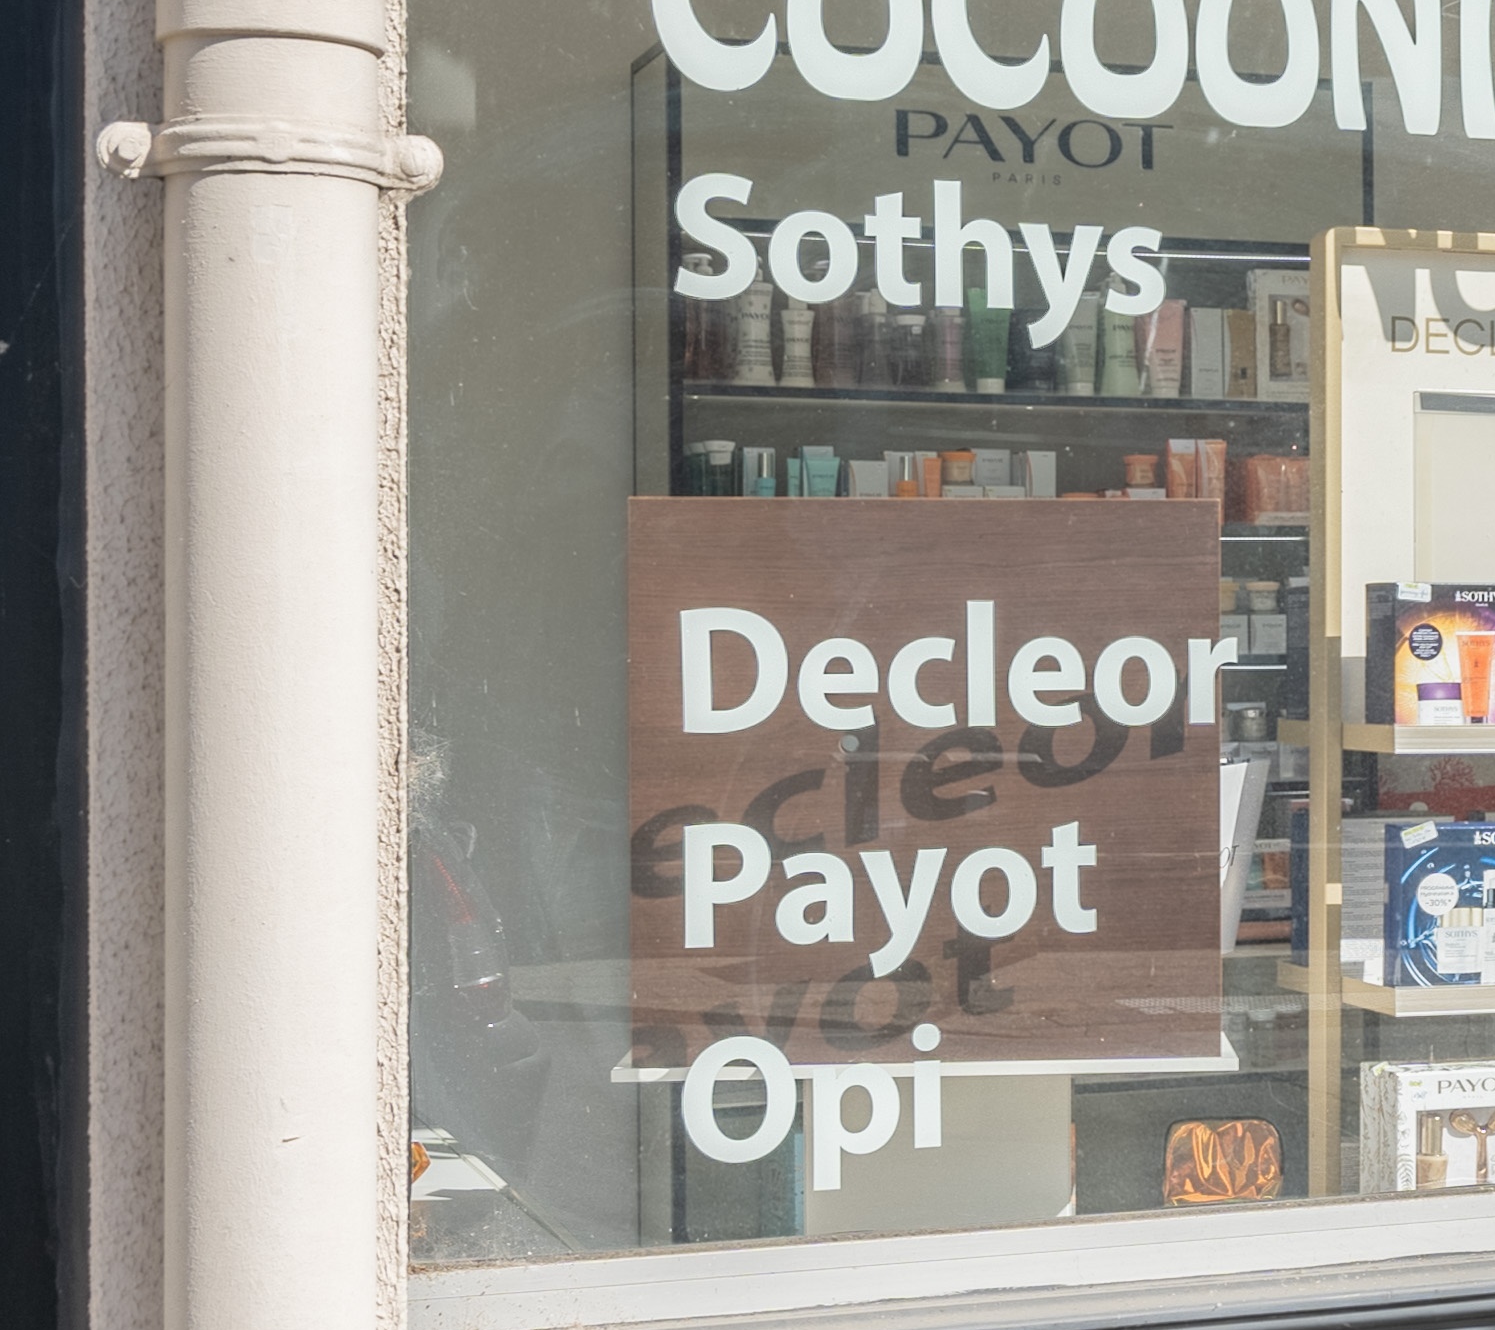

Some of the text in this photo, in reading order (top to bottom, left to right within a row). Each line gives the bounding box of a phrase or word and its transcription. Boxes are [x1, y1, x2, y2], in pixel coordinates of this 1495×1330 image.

[895, 109, 1174, 170] PAYOT
[992, 172, 1062, 186] PARIS
[674, 172, 1167, 349] Sothys
[679, 600, 1239, 734] Decleor
[683, 821, 1098, 978] Payot
[682, 1023, 942, 1191] Opi
